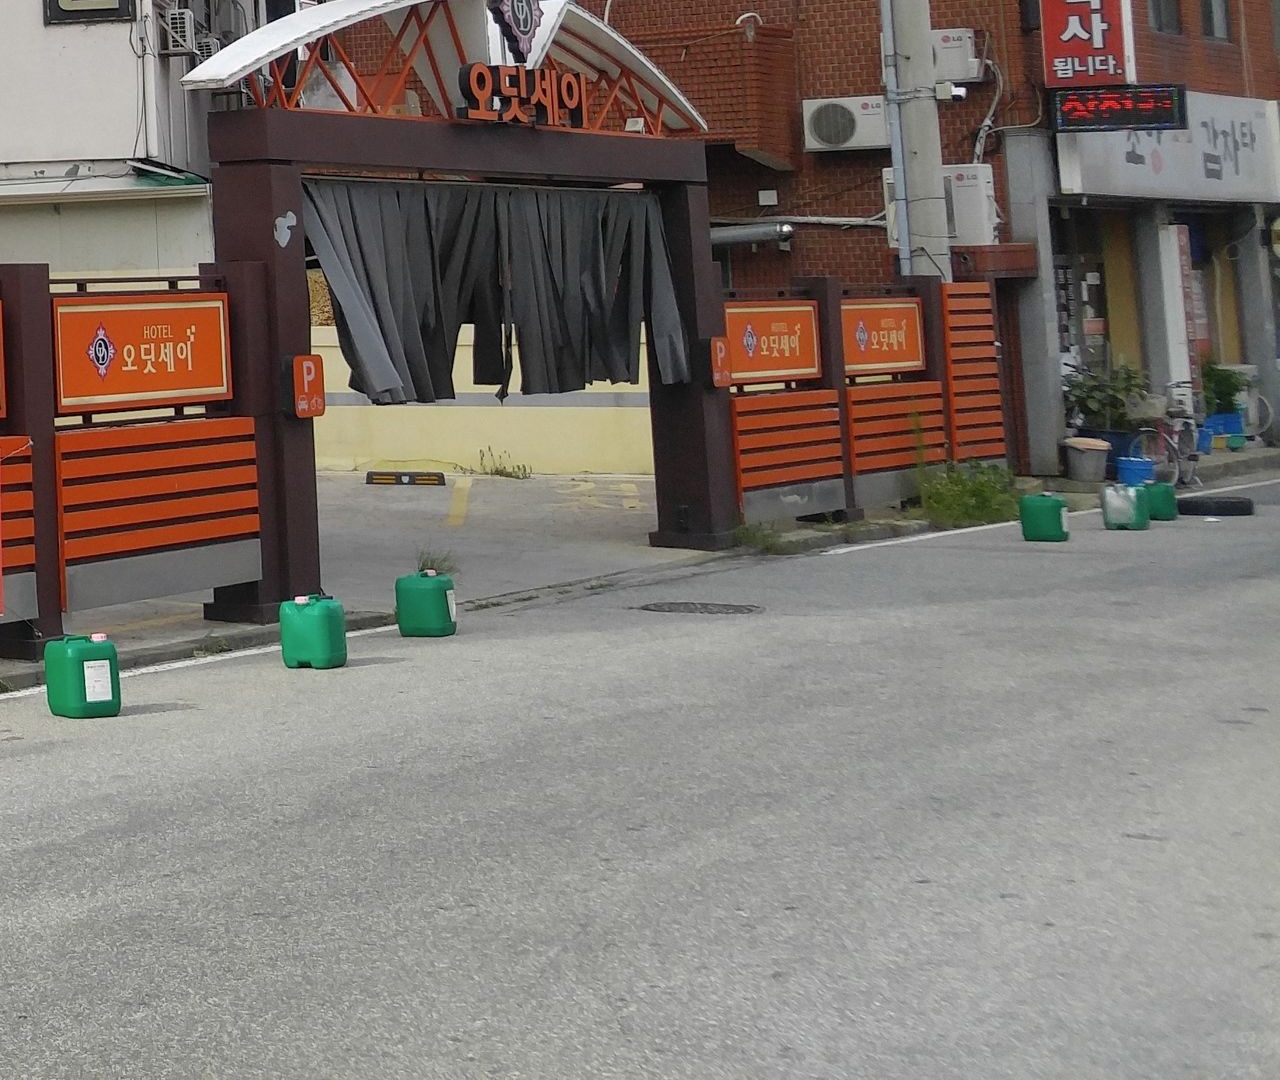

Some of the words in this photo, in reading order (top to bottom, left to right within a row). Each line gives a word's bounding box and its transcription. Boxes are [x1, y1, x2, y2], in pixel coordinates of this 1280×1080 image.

[1051, 54, 1124, 79] 됩니다.
[467, 62, 592, 129] 오딧세이
[143, 325, 174, 339] HOTEL
[121, 341, 193, 374] 오딧세이
[716, 341, 726, 366] P
[302, 360, 316, 393] P
